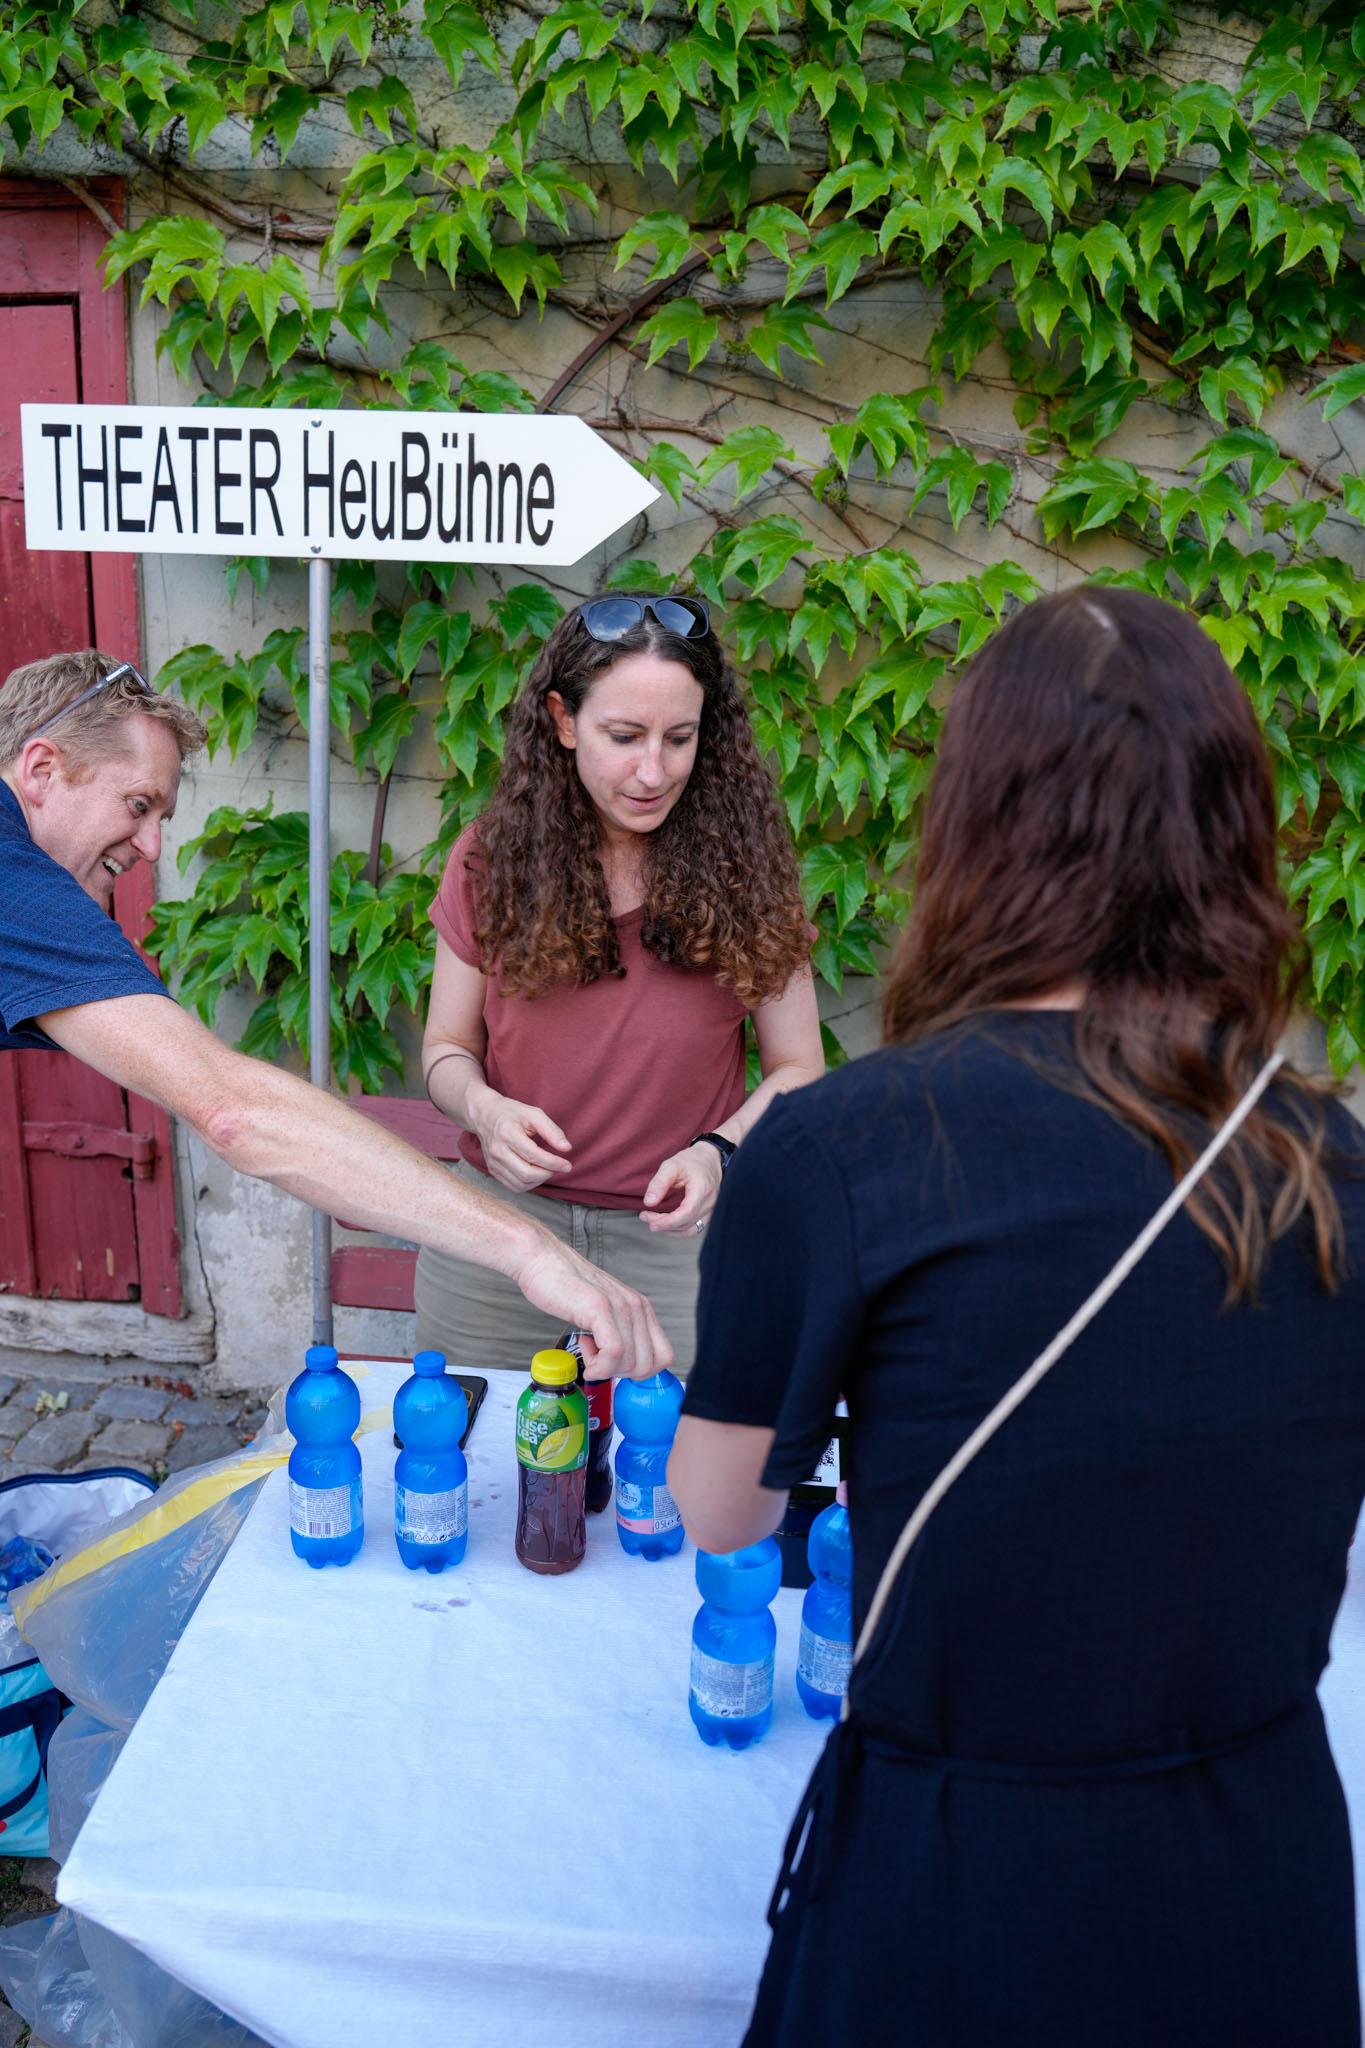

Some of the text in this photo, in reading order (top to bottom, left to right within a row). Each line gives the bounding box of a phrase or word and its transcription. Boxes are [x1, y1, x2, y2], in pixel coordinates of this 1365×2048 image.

[41, 423, 555, 546] THEATER HeuBühne
[517, 1408, 548, 1435] fuse
[517, 1425, 538, 1445] tea
